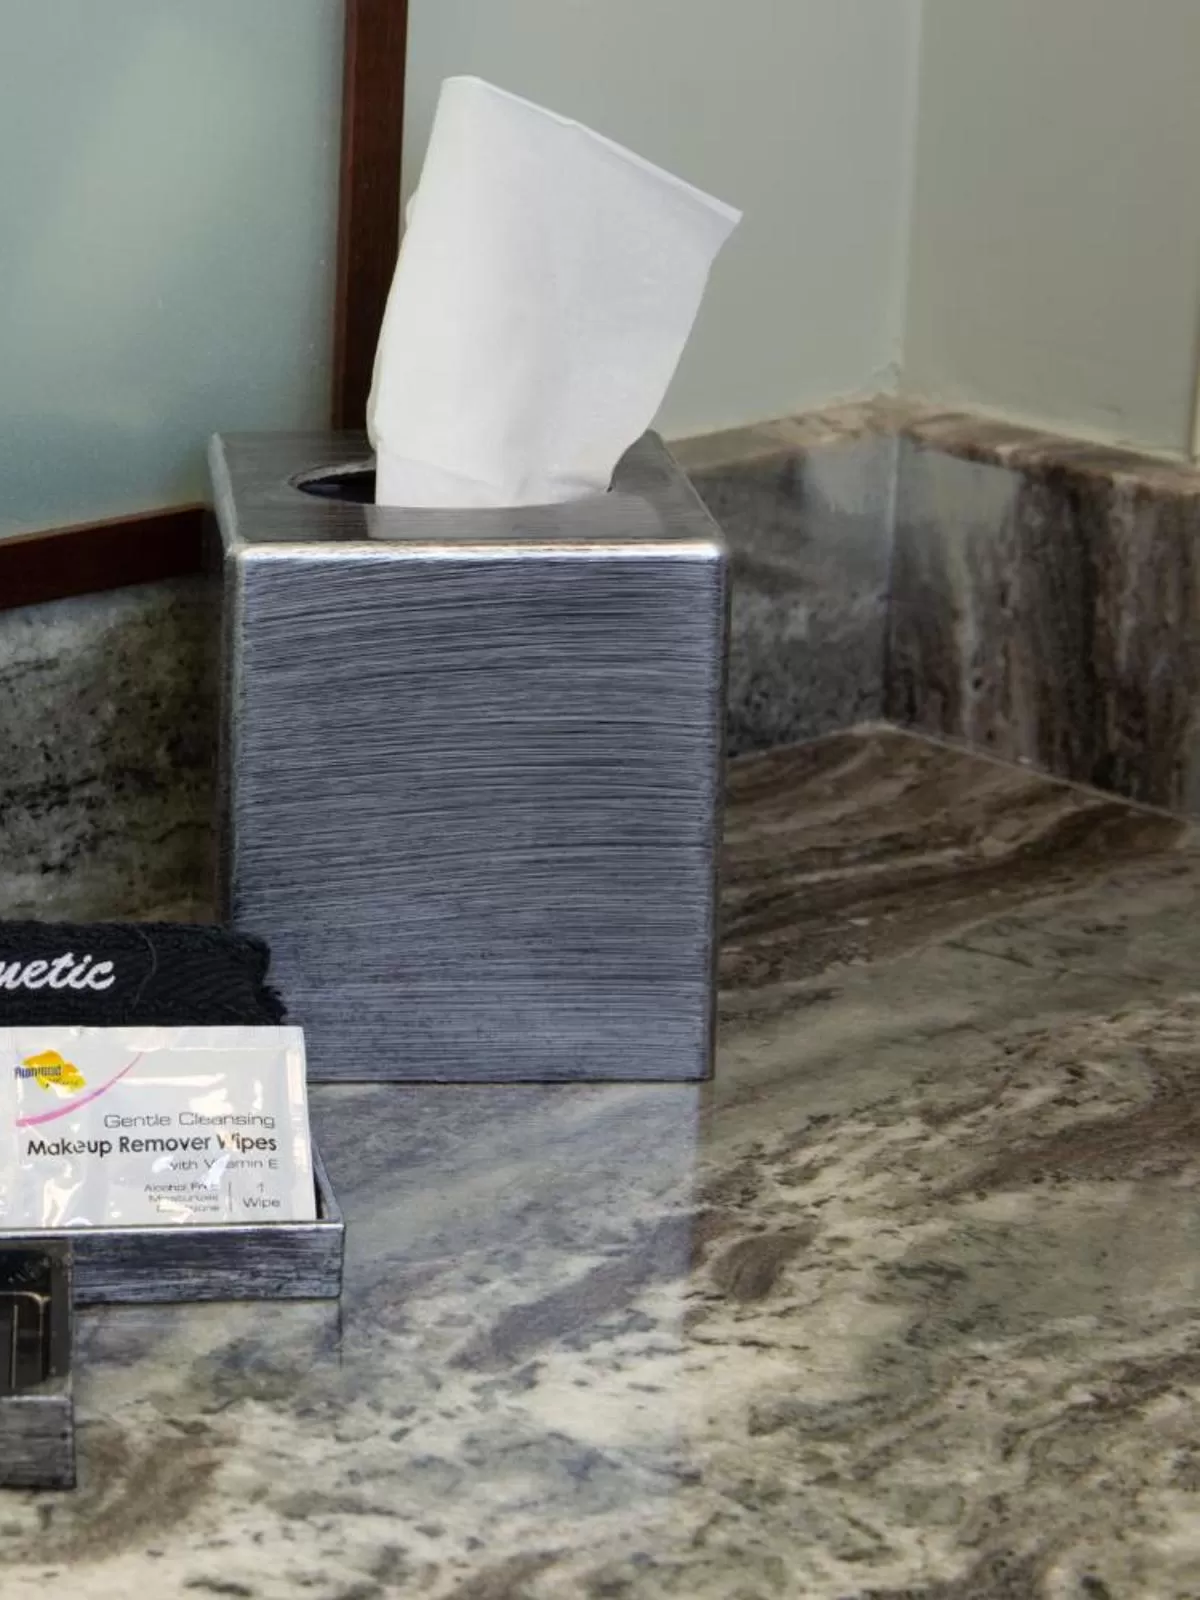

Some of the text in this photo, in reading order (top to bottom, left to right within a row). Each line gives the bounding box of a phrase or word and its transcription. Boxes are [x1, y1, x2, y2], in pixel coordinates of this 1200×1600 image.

[103, 1112, 276, 1130] Gentle Cleansing
[27, 1138, 113, 1158] Makeup
[119, 1135, 211, 1153] Remover
[268, 1158, 279, 1170] E
[242, 1196, 281, 1209] Wipe
